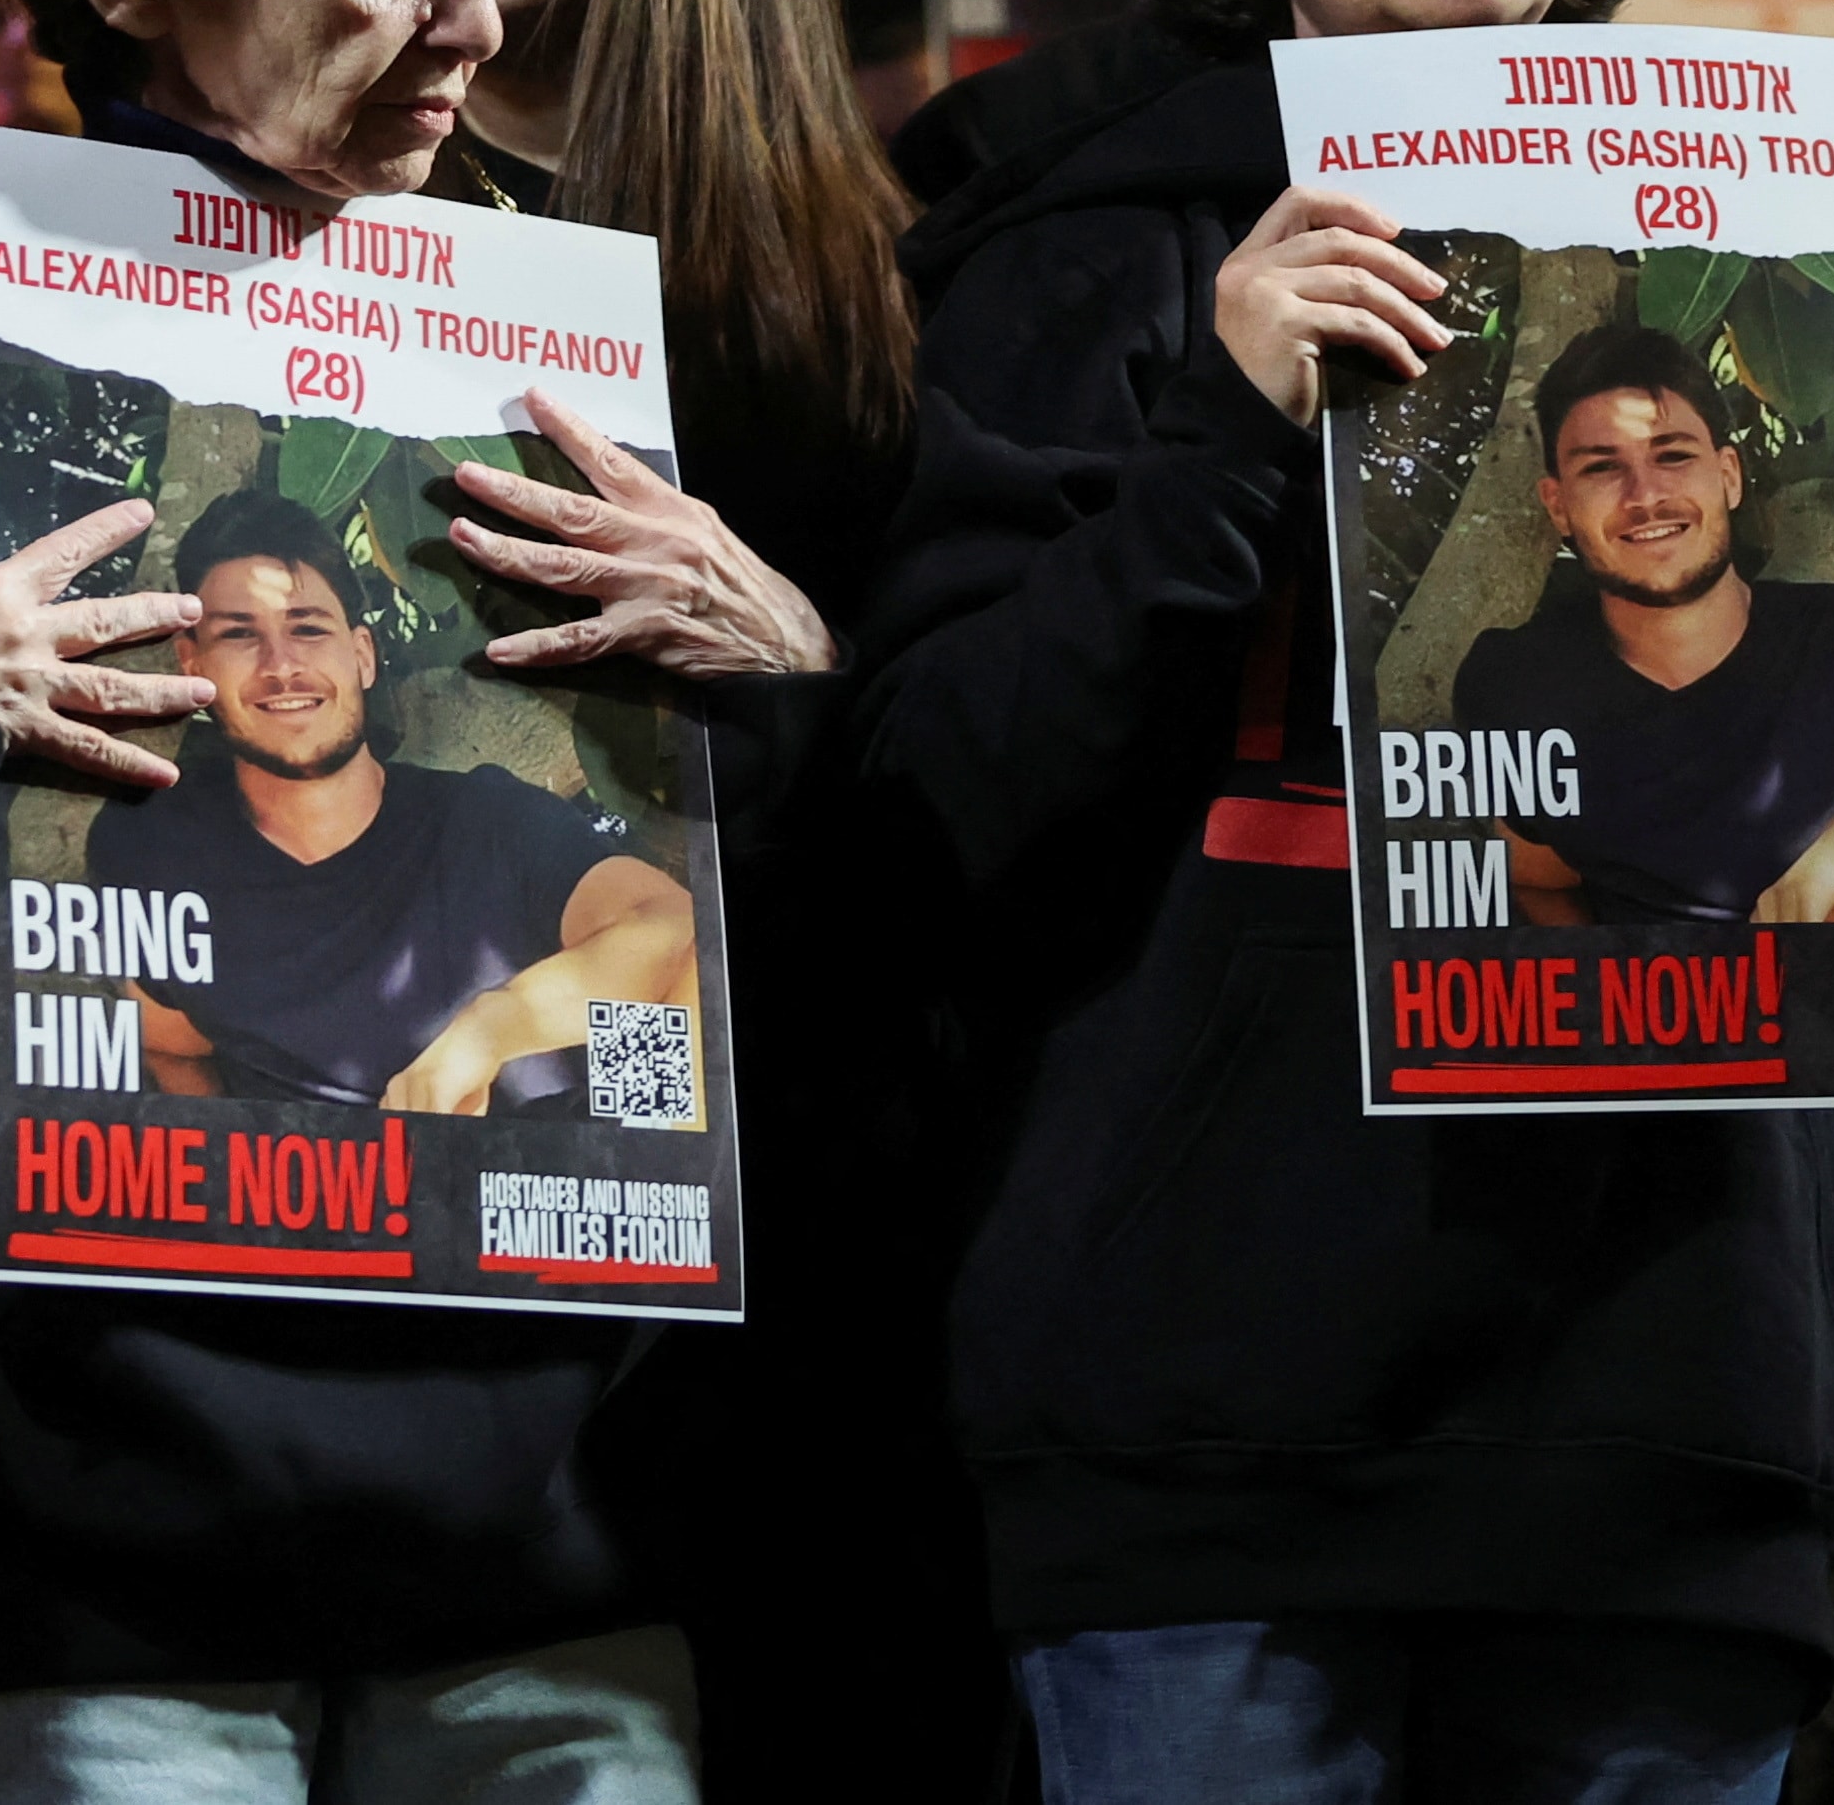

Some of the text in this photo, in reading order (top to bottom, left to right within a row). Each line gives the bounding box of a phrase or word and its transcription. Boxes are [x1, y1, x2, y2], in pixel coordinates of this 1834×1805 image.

[1498, 55, 1797, 115] אלכסנדר טרופנוב
[1317, 127, 1572, 173] ALEXANDER
[1586, 128, 1749, 180] (SASHA)
[171, 188, 456, 289] אלכסנדר טרופנוב
[1634, 183, 1719, 241] (28)
[246, 280, 401, 353] (SASHA)
[414, 307, 644, 380] TROUFANOV
[284, 345, 365, 414] (28)
[1378, 728, 1581, 819] BRING
[1385, 840, 1510, 929] HIM
[10, 878, 214, 984] BRING
[1390, 931, 1785, 1049] HOME NOW!
[15, 992, 141, 1093] HIM
[16, 1117, 416, 1237] HOME NOW!
[479, 1171, 711, 1221] HOSTAGES AND MISSING
[480, 1207, 713, 1268] FAMILIES FORUM
